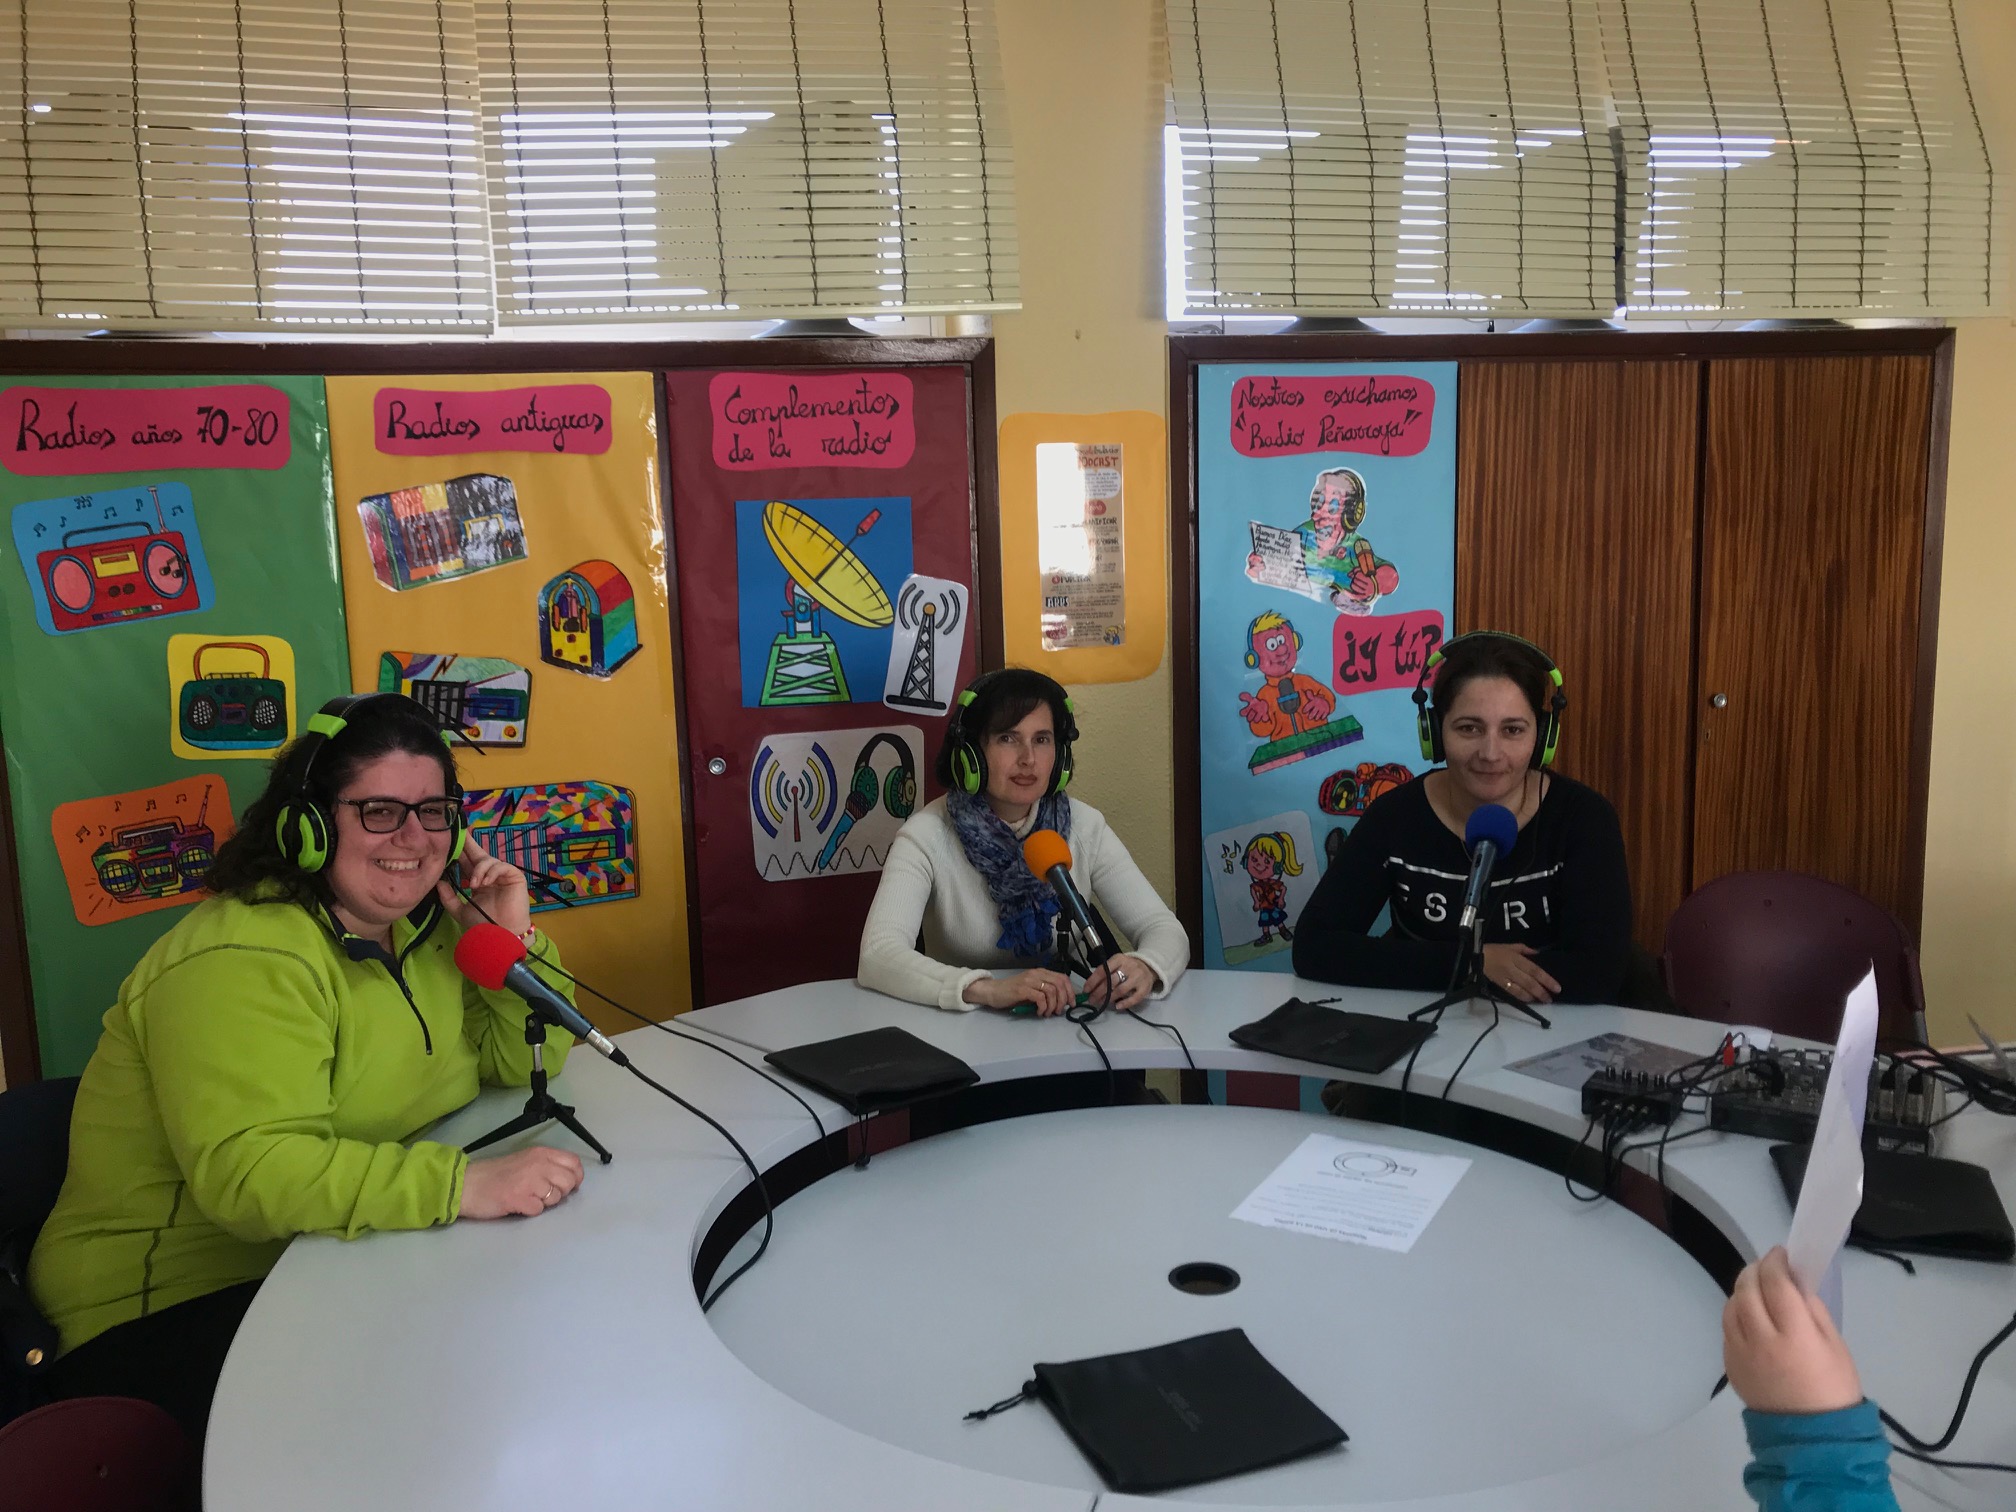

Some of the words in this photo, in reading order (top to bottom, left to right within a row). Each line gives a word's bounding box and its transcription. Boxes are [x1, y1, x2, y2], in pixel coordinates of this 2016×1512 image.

[724, 377, 900, 437] Complementos
[1237, 376, 1305, 409] Nosotros
[1324, 377, 1418, 407] escuchamos
[16, 399, 116, 451] Radios
[131, 425, 183, 445] años
[196, 406, 278, 446] 70-80
[387, 400, 480, 440] Radios
[501, 394, 604, 452] antiguas
[728, 434, 754, 463] de
[769, 428, 791, 458] la
[822, 419, 893, 455] radio
[1389, 620, 1442, 681] tú?
